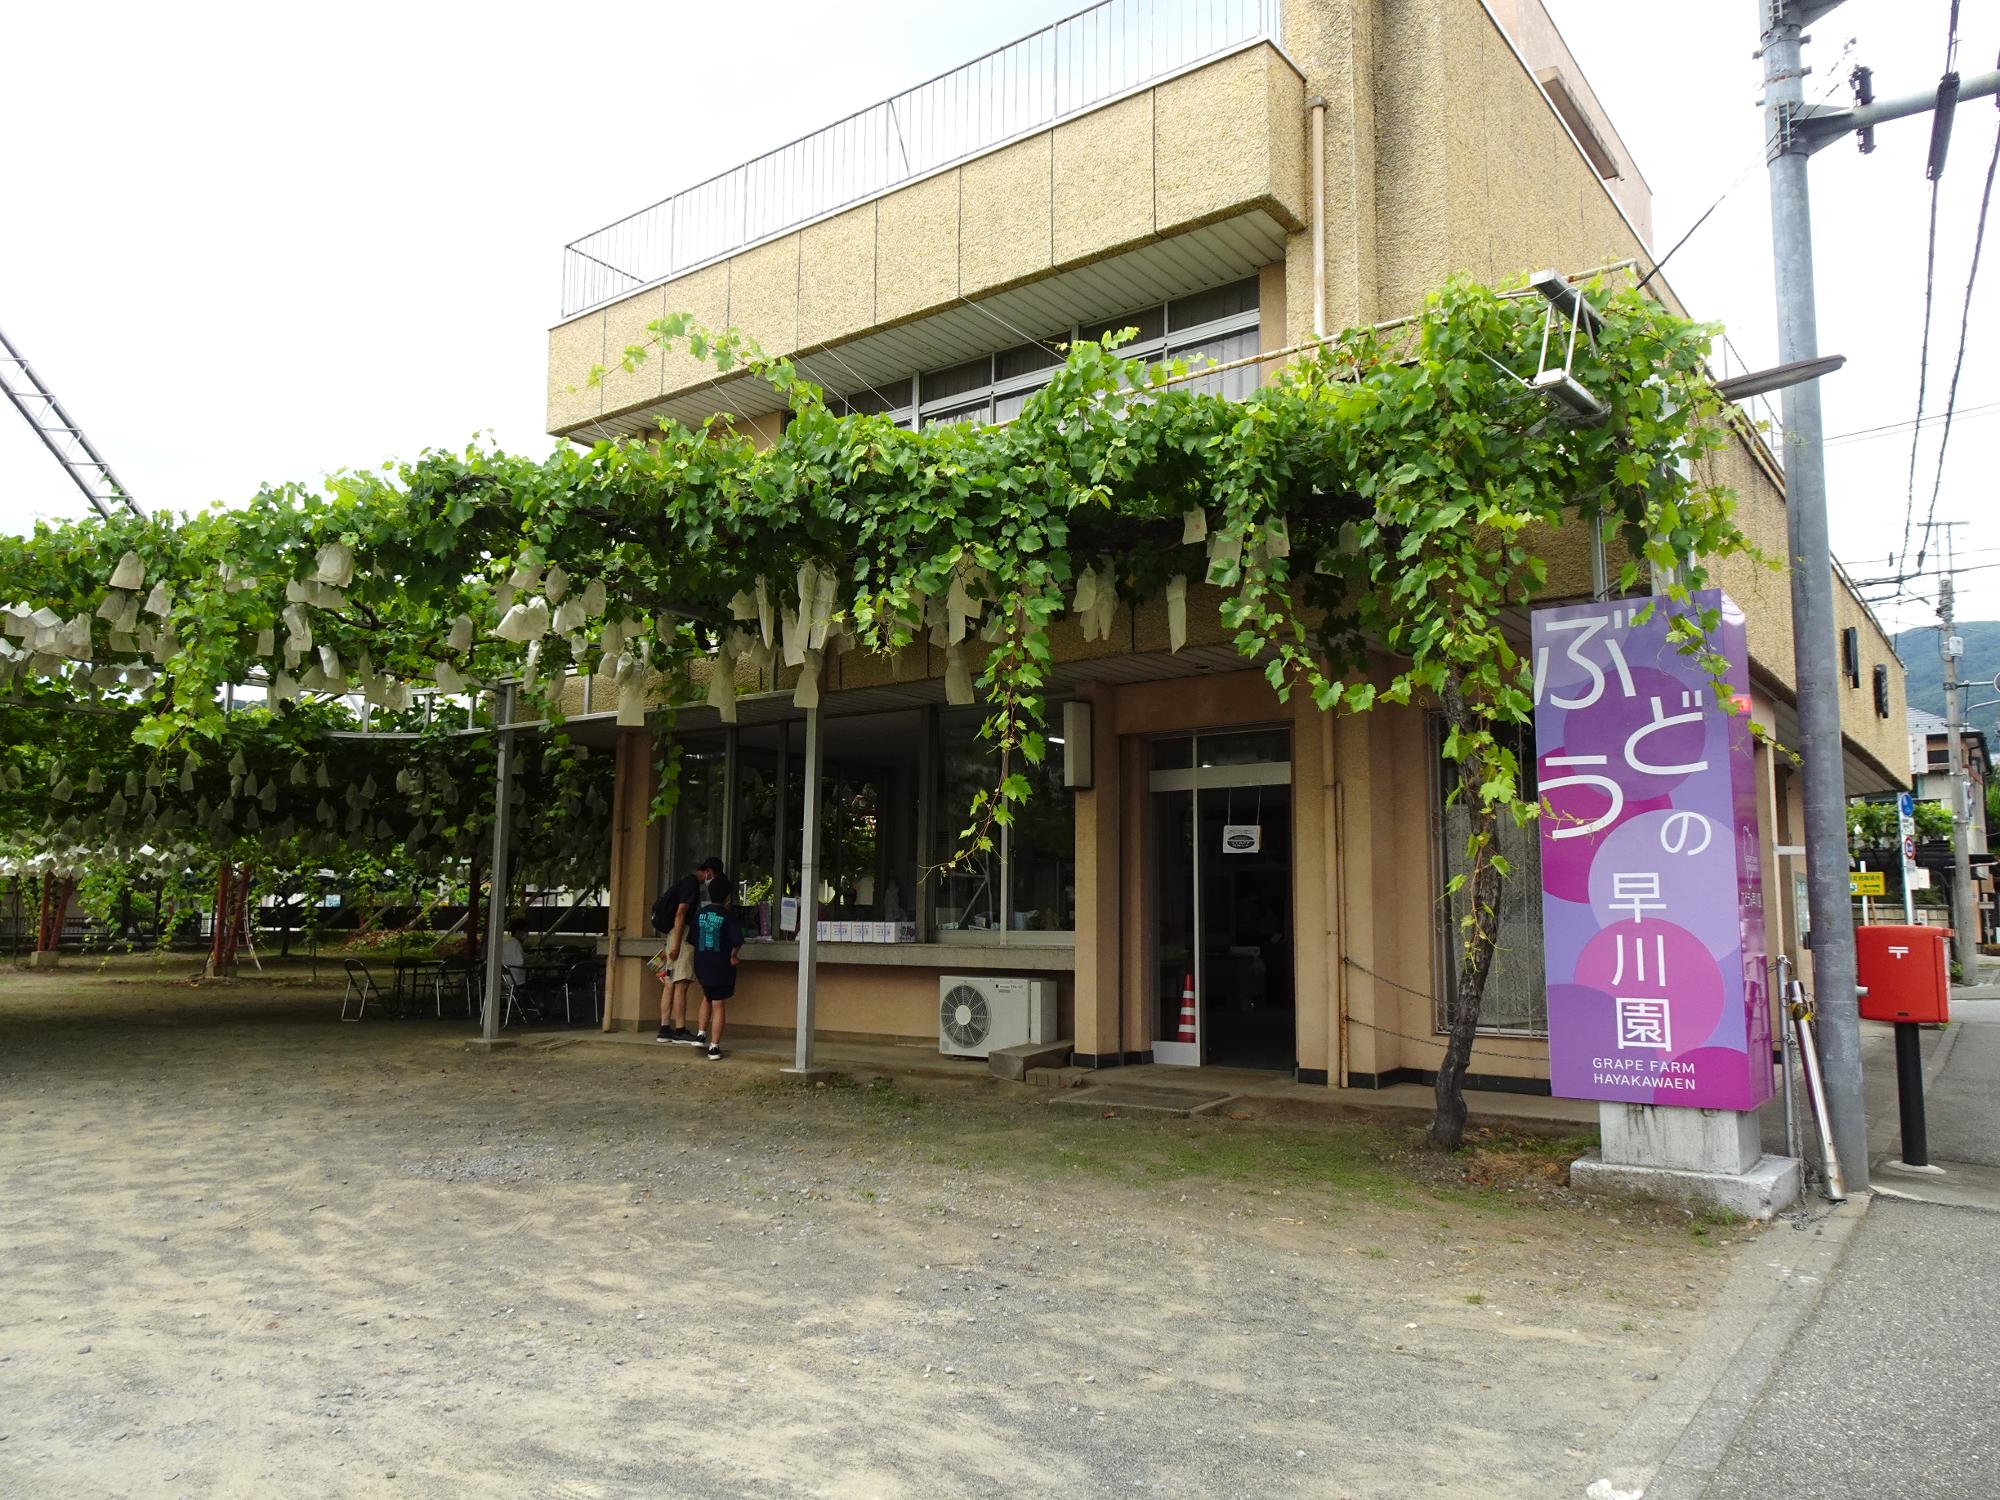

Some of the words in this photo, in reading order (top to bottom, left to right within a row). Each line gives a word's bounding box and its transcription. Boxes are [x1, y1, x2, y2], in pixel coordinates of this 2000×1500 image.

[1592, 1057, 1644, 1071] GRAPE
[1650, 1060, 1695, 1074] FARM
[1593, 1073, 1696, 1090] HAYAKAWAEN
